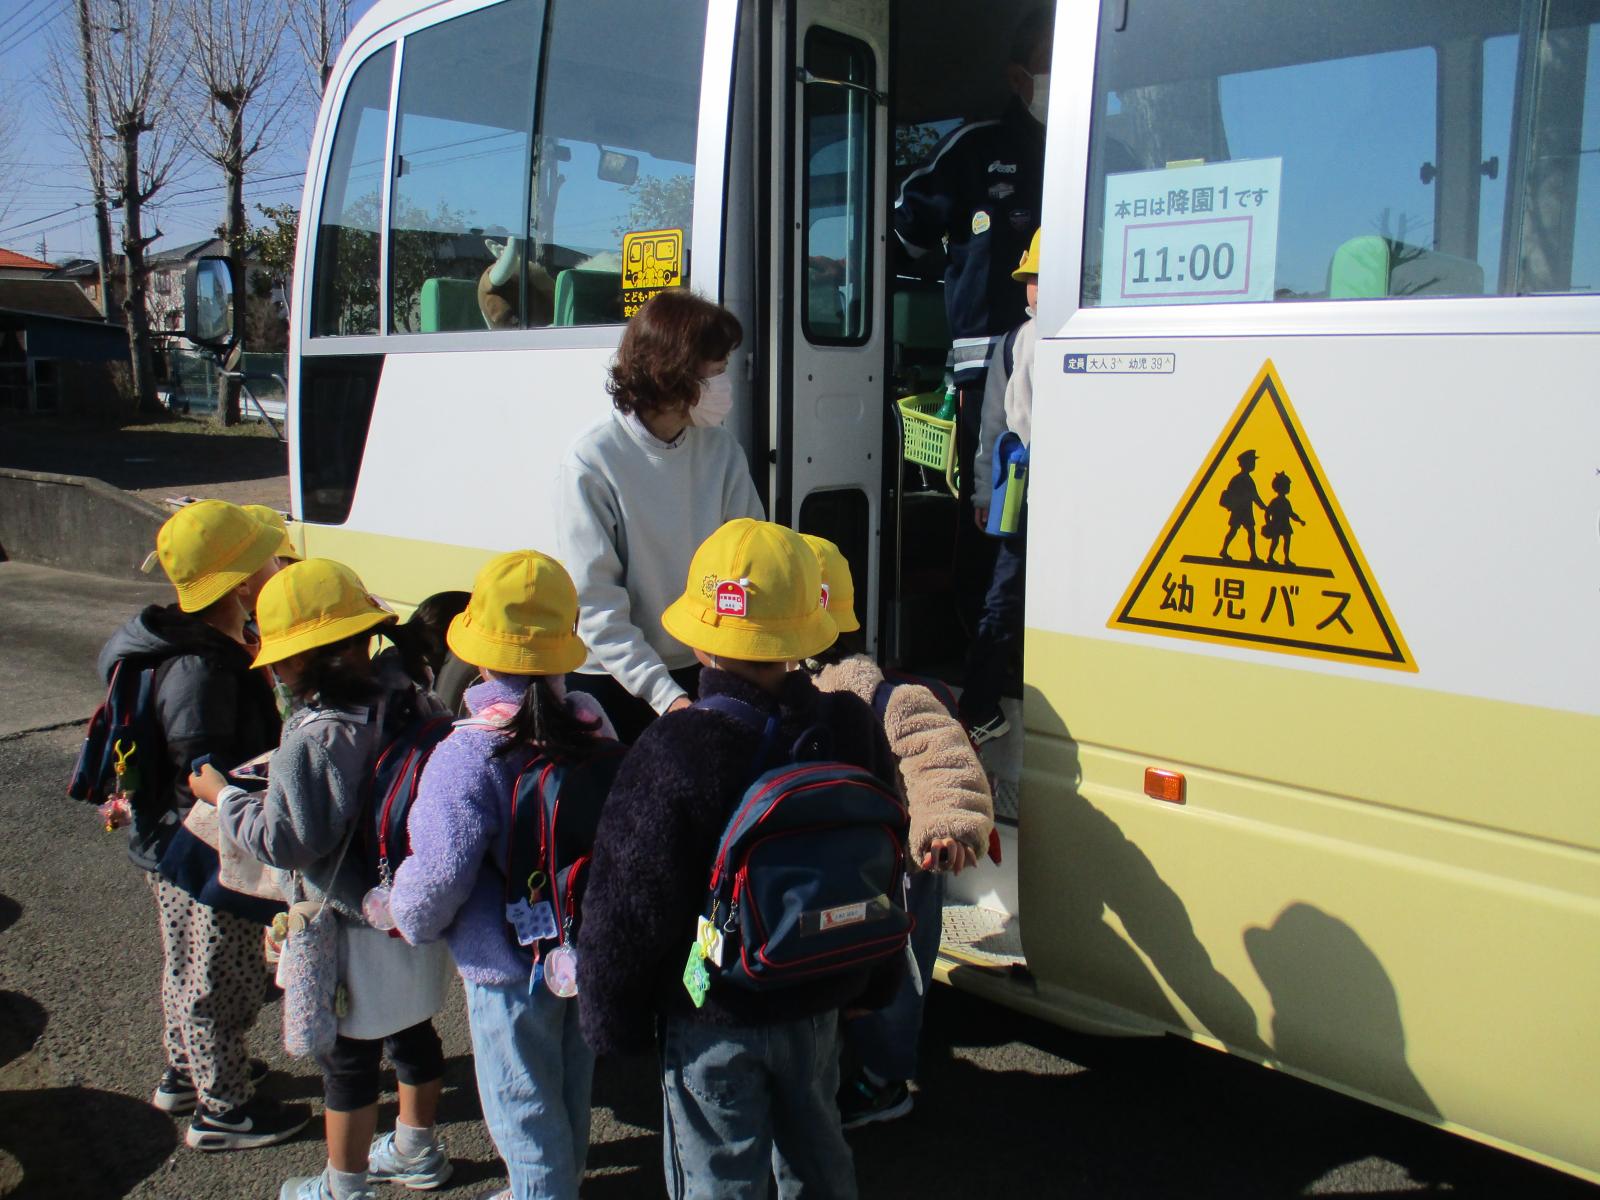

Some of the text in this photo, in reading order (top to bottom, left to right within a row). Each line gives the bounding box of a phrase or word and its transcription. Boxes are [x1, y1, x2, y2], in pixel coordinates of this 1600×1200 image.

[1114, 186, 1269, 219] 本日は降園1です
[1132, 242, 1235, 283] 11:00
[1068, 358, 1085, 370] 定員
[1159, 572, 1354, 635] 幼児バス
